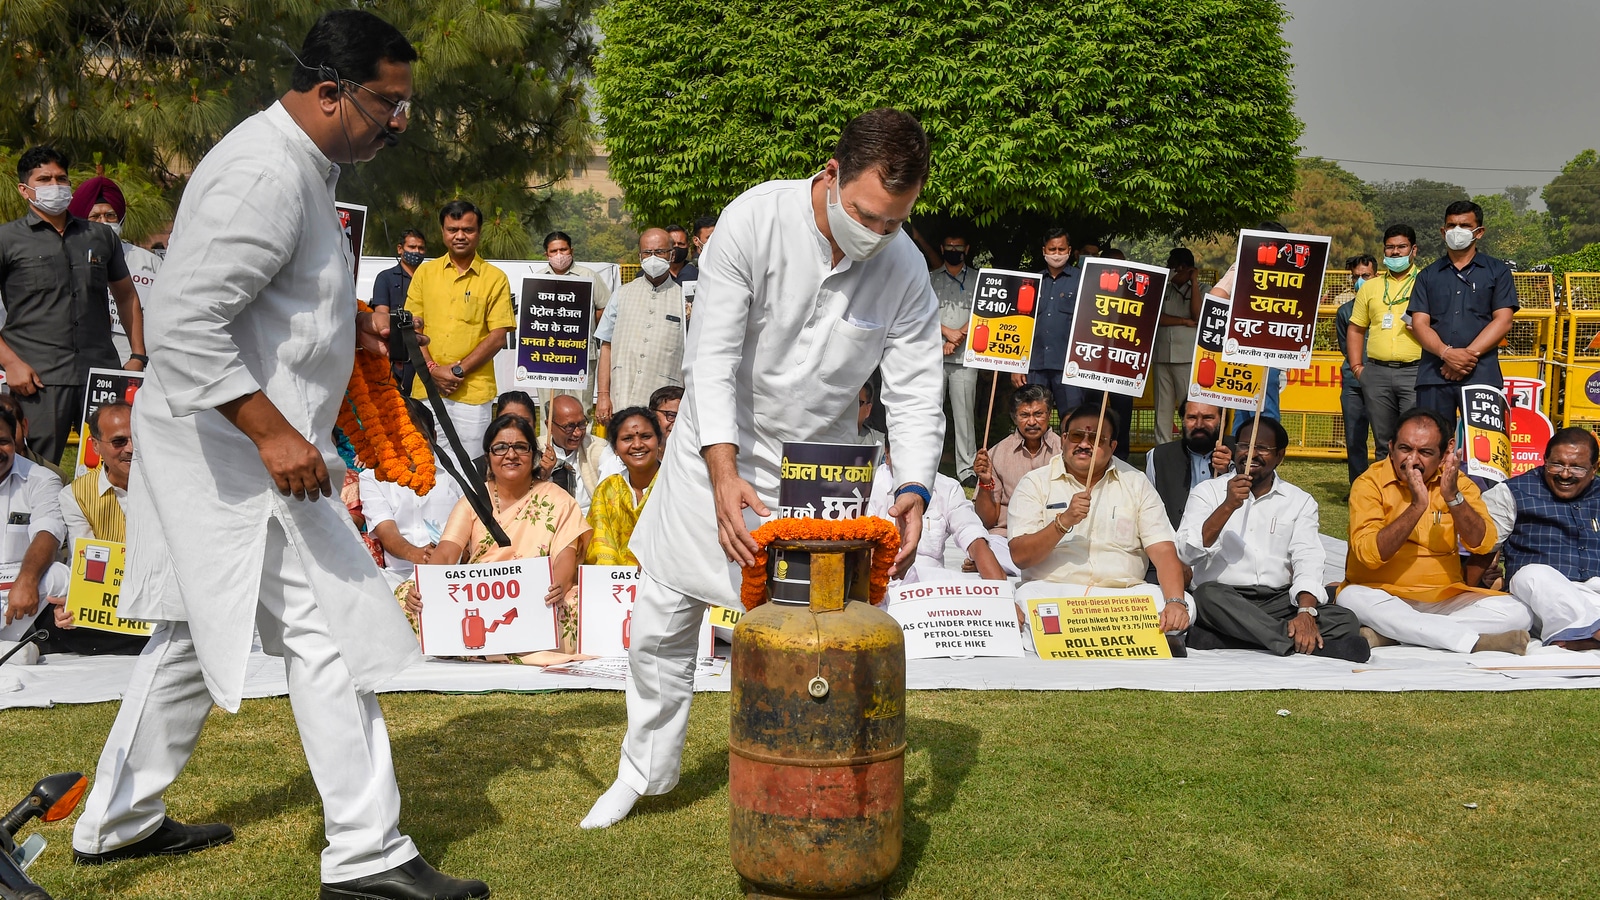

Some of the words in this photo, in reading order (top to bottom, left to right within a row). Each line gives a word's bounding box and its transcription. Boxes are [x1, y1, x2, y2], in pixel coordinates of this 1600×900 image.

[986, 278, 1002, 286] 2014
[1253, 268, 1305, 290] चुनाव
[538, 292, 555, 301] कम
[558, 292, 576, 302] करो
[980, 287, 1008, 300] LPG
[978, 300, 1016, 314] ₹410/-
[1096, 294, 1144, 316] चुनाव
[1250, 296, 1303, 318] खत्म,
[531, 320, 548, 332] गैस
[551, 322, 561, 332] के
[563, 324, 580, 334] दाम
[1000, 324, 1017, 332] 2022
[1206, 316, 1228, 330] LP
[1234, 318, 1264, 338] लूट
[996, 332, 1020, 343] LPG
[1092, 320, 1141, 346] खत्म,
[521, 337, 546, 347] जनता
[548, 337, 556, 347] है
[557, 339, 587, 350] महंगाई
[989, 342, 1028, 356] ₹954/-
[530, 351, 540, 362] से
[542, 352, 577, 364] परेशान!
[1076, 342, 1104, 362] लूट
[1263, 352, 1276, 360] युवा
[1078, 372, 1100, 380] भारतीय
[1102, 375, 1114, 384] युवा
[1224, 368, 1252, 380] LPG
[96, 379, 112, 388] 2014
[92, 390, 116, 404] LPG
[1475, 392, 1494, 401] 2014
[1472, 401, 1500, 414] LPG
[1516, 452, 1542, 460] GOVT.
[820, 464, 843, 482] पर
[445, 568, 466, 580] GAS
[468, 566, 522, 579] CYLINDER
[611, 572, 632, 580] GAS
[448, 579, 520, 603] ₹1000
[900, 587, 934, 600] STOP
[937, 586, 962, 596] THE
[965, 586, 1000, 596] LOOT
[1066, 598, 1110, 606] Petrol-Diesel
[79, 608, 113, 626] FUEL
[927, 609, 982, 618] WITHDRAW
[1089, 616, 1108, 624] hiked
[1110, 616, 1118, 624] by
[903, 622, 915, 631] AS
[918, 620, 964, 629] CYLINDER
[995, 620, 1016, 628] HIKE
[1069, 626, 1090, 634] Diesel
[1092, 624, 1110, 632] hiked
[1112, 624, 1120, 632] by
[924, 630, 994, 639] PETROL-DIESEL
[936, 640, 963, 648] PRICE
[964, 640, 986, 648] HIKE
[1065, 638, 1098, 648] ROLL
[1100, 635, 1136, 646] BACK
[1086, 648, 1124, 658] PRICE
[1124, 646, 1158, 656] HIKE
